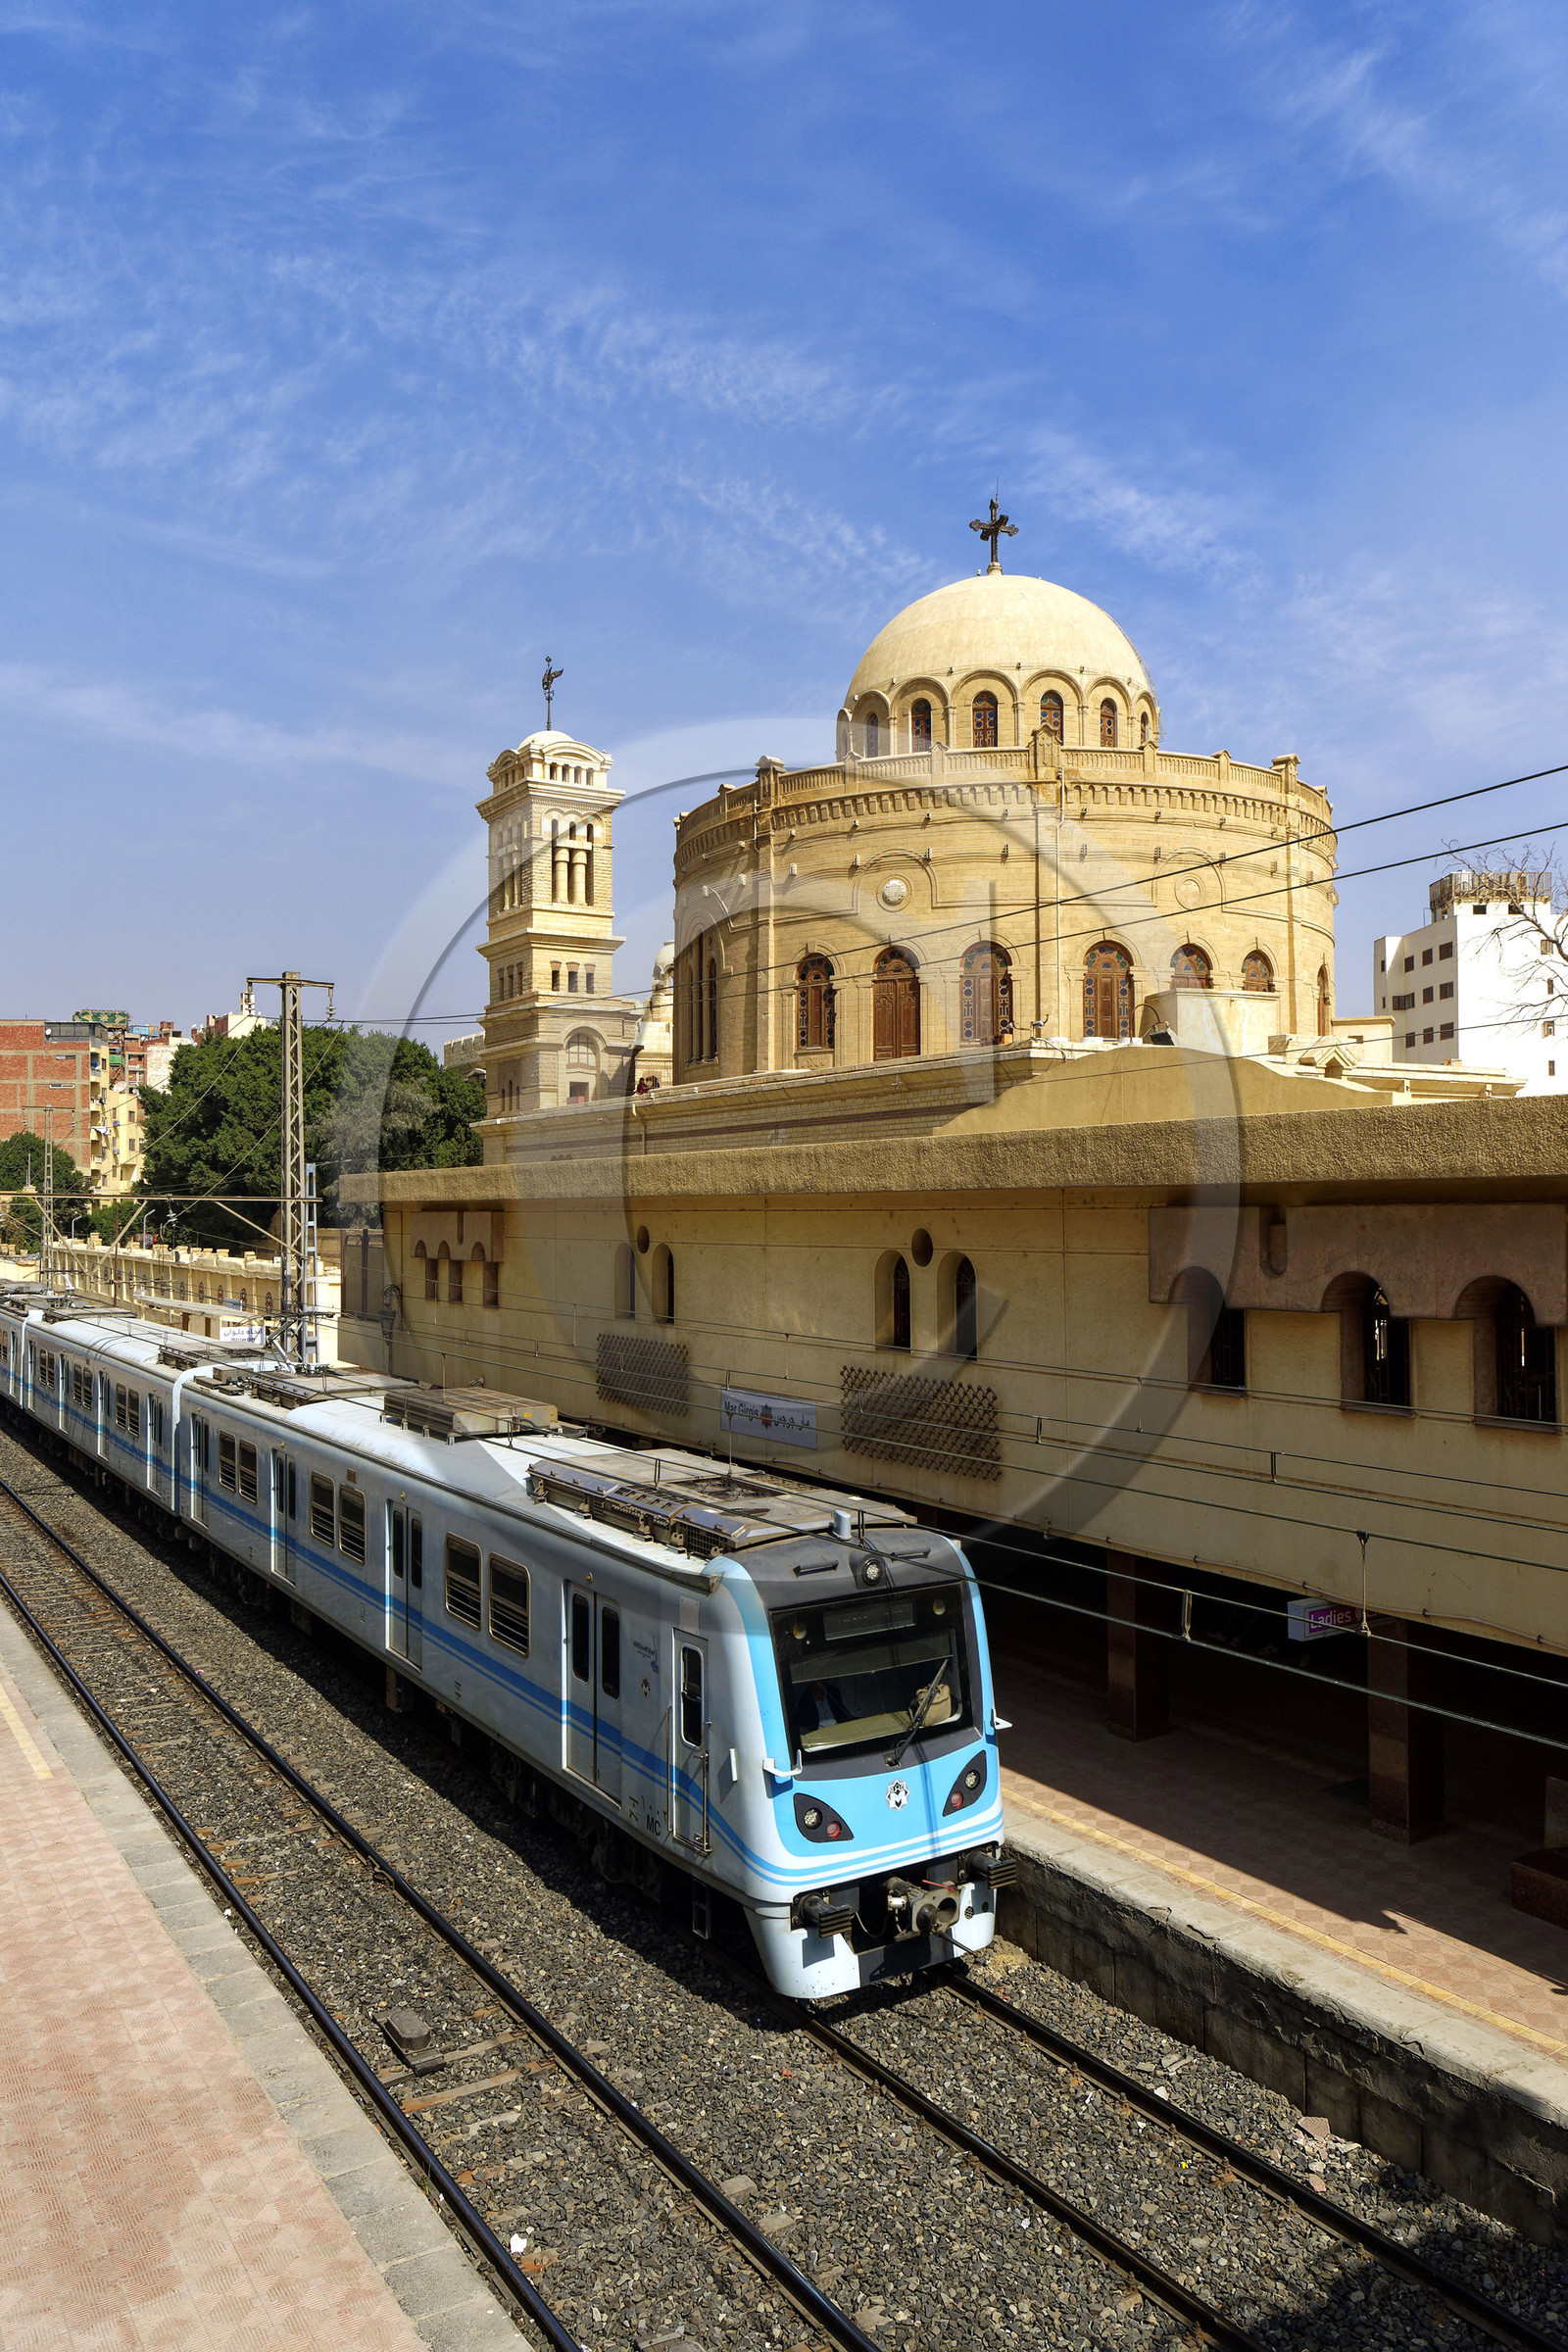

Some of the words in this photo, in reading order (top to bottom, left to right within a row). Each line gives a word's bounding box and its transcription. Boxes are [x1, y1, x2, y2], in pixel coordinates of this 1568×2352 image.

[724, 1400, 737, 1412] Mar
[738, 1402, 760, 1422] Girgis
[1310, 1609, 1351, 1630] Ladies
[646, 1813, 662, 1837] MC
